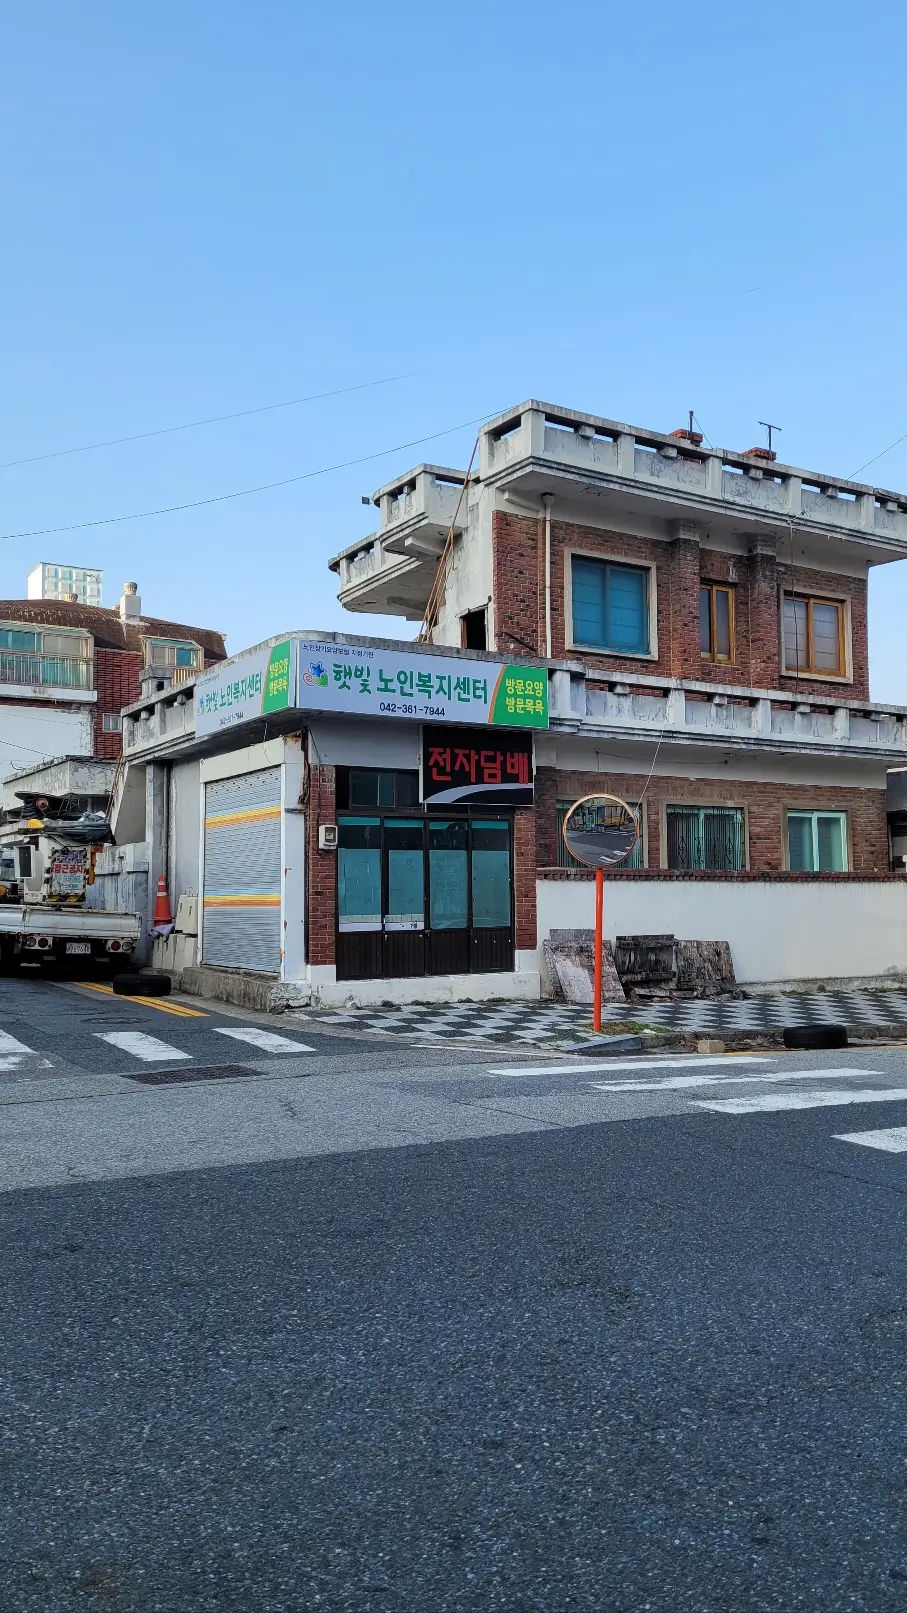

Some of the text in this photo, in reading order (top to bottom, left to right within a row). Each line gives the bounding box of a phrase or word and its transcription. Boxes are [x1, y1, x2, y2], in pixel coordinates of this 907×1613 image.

[269, 658, 289, 679] 방문요양
[205, 690, 219, 714] 햇빛
[219, 670, 262, 707] 노인복지센터
[268, 676, 288, 697] 방문목욕
[332, 663, 488, 705] 햇빛 노인복지센터
[505, 678, 544, 698] 방문요양
[379, 702, 446, 717] 042-361-7944
[505, 697, 545, 716] 방문목욕
[428, 747, 529, 785] 전자담배
